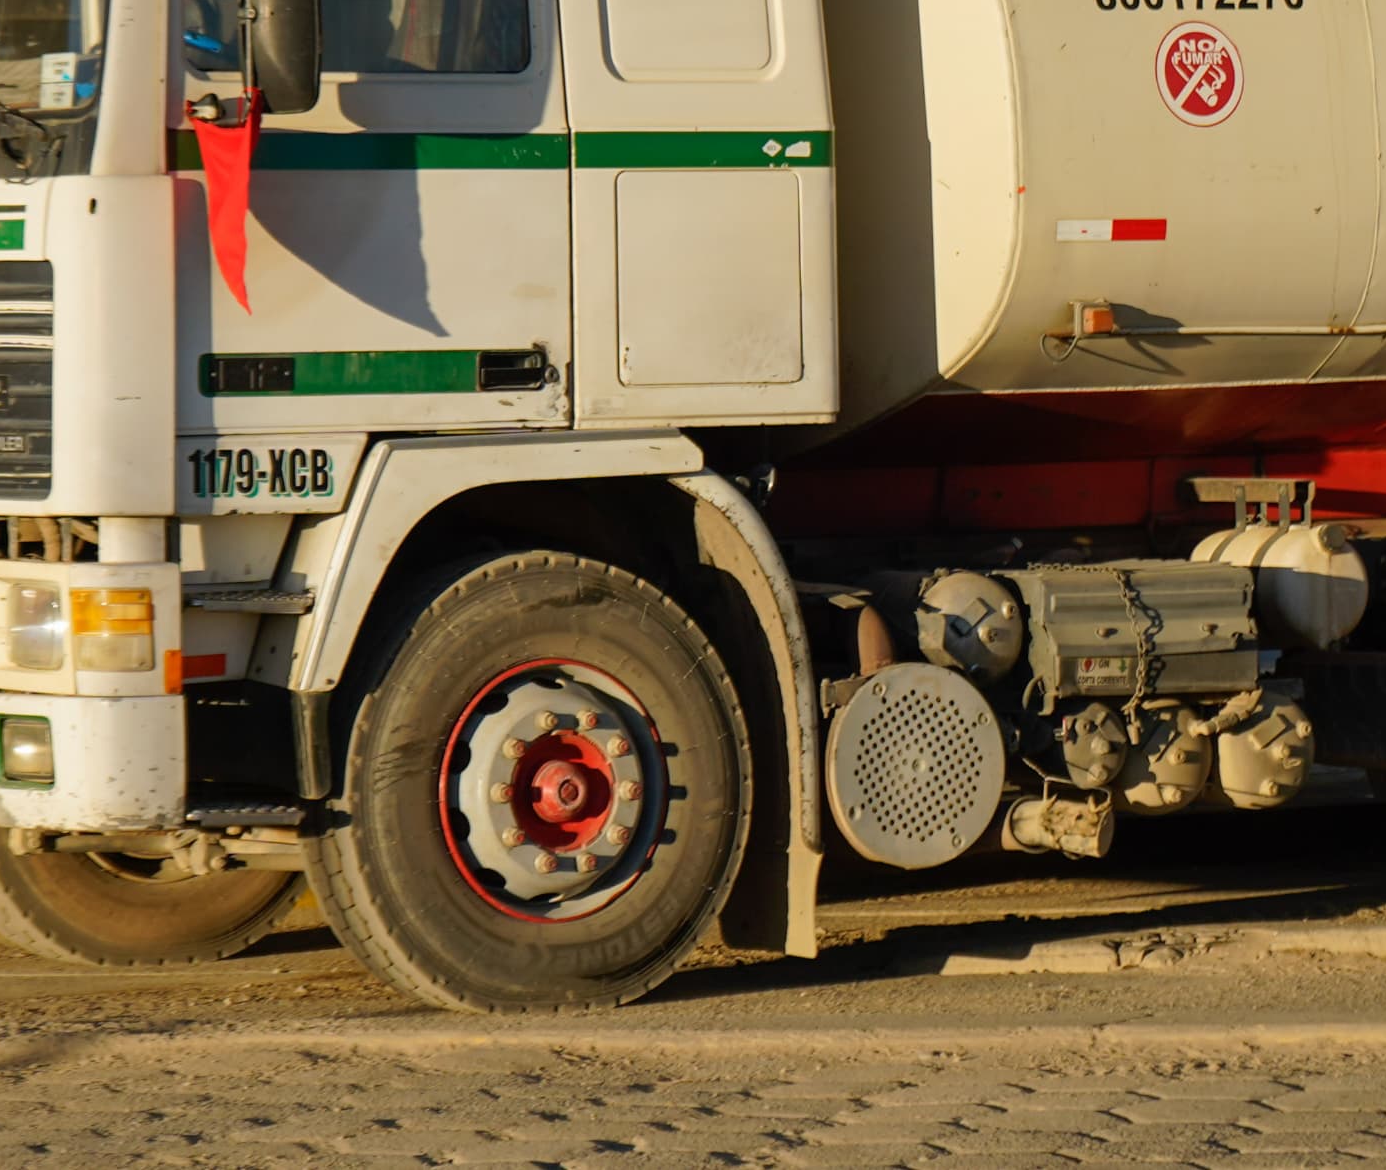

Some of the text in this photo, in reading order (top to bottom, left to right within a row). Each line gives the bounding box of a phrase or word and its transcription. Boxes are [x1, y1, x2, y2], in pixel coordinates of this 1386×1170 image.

[1178, 38, 1217, 52] NO
[1172, 52, 1224, 66] FUMAR
[188, 447, 333, 497] 1179-XCB
